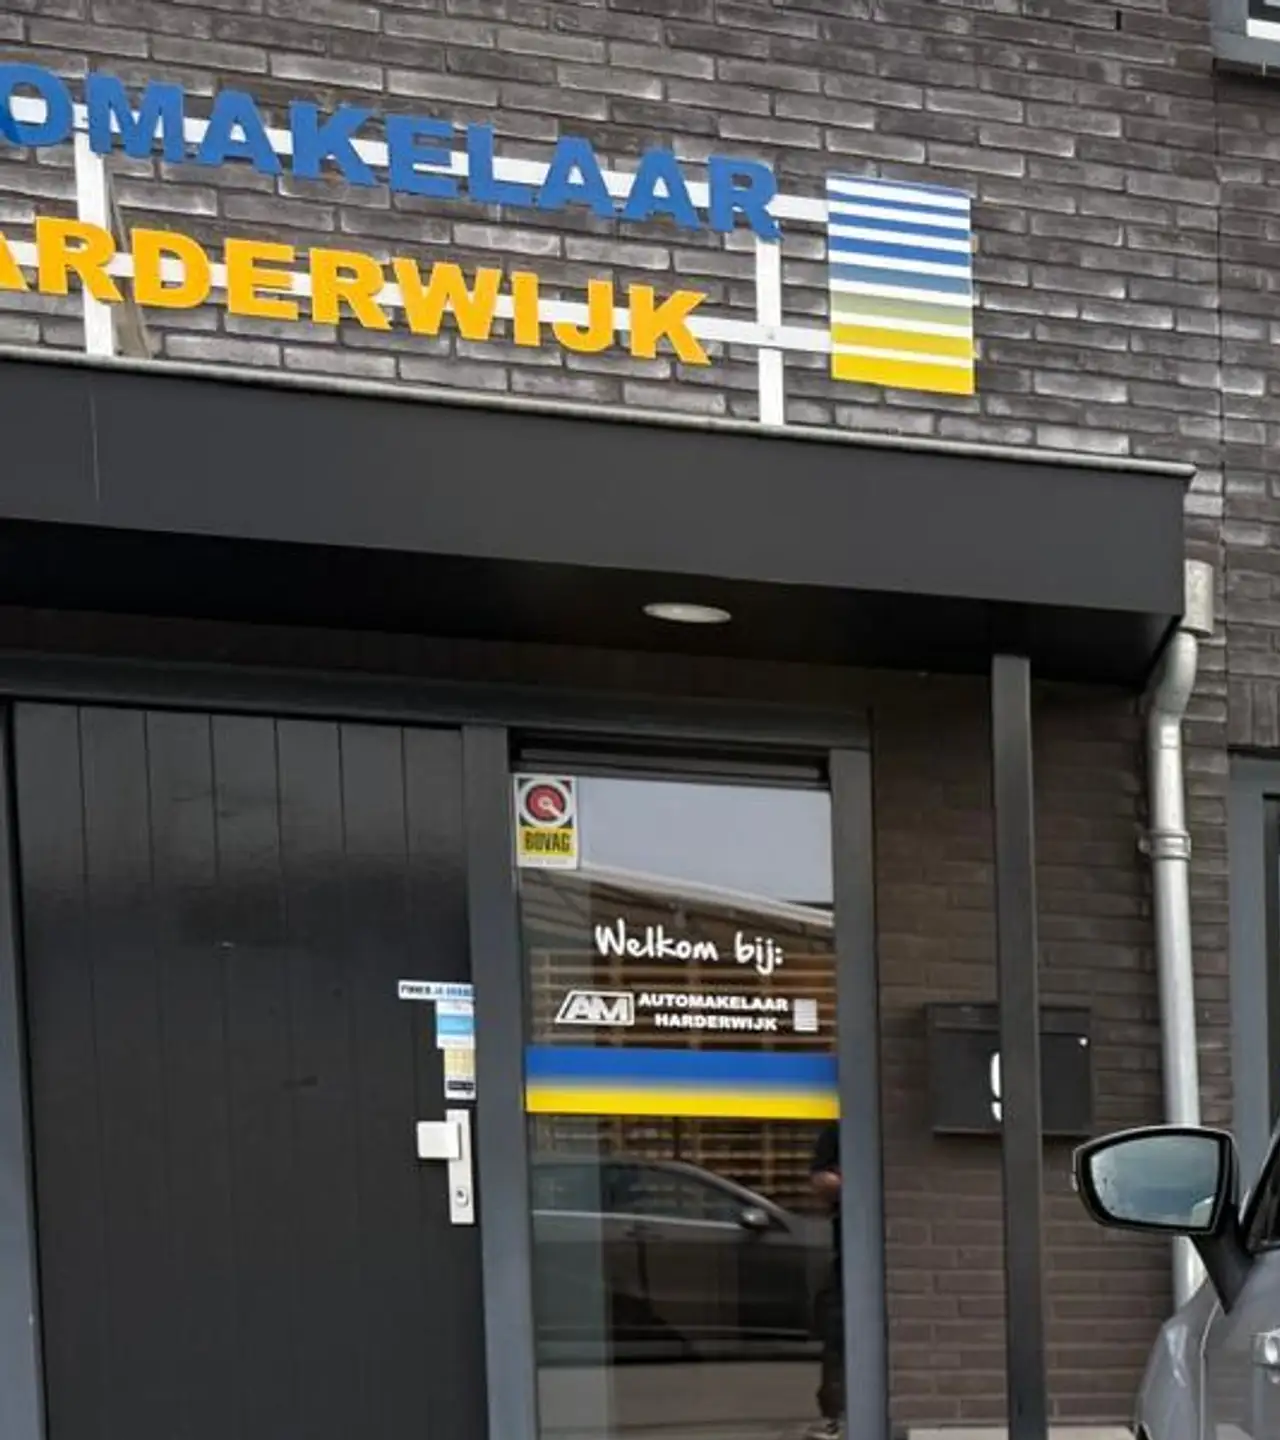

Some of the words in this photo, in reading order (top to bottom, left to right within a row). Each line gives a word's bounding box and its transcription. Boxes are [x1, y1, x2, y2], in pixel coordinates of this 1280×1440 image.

[594, 917, 719, 961] Welkom
[734, 931, 784, 976] bij:
[638, 992, 789, 1012] AUTOMAKELAAR
[654, 1013, 778, 1031] HARDERWIJK
